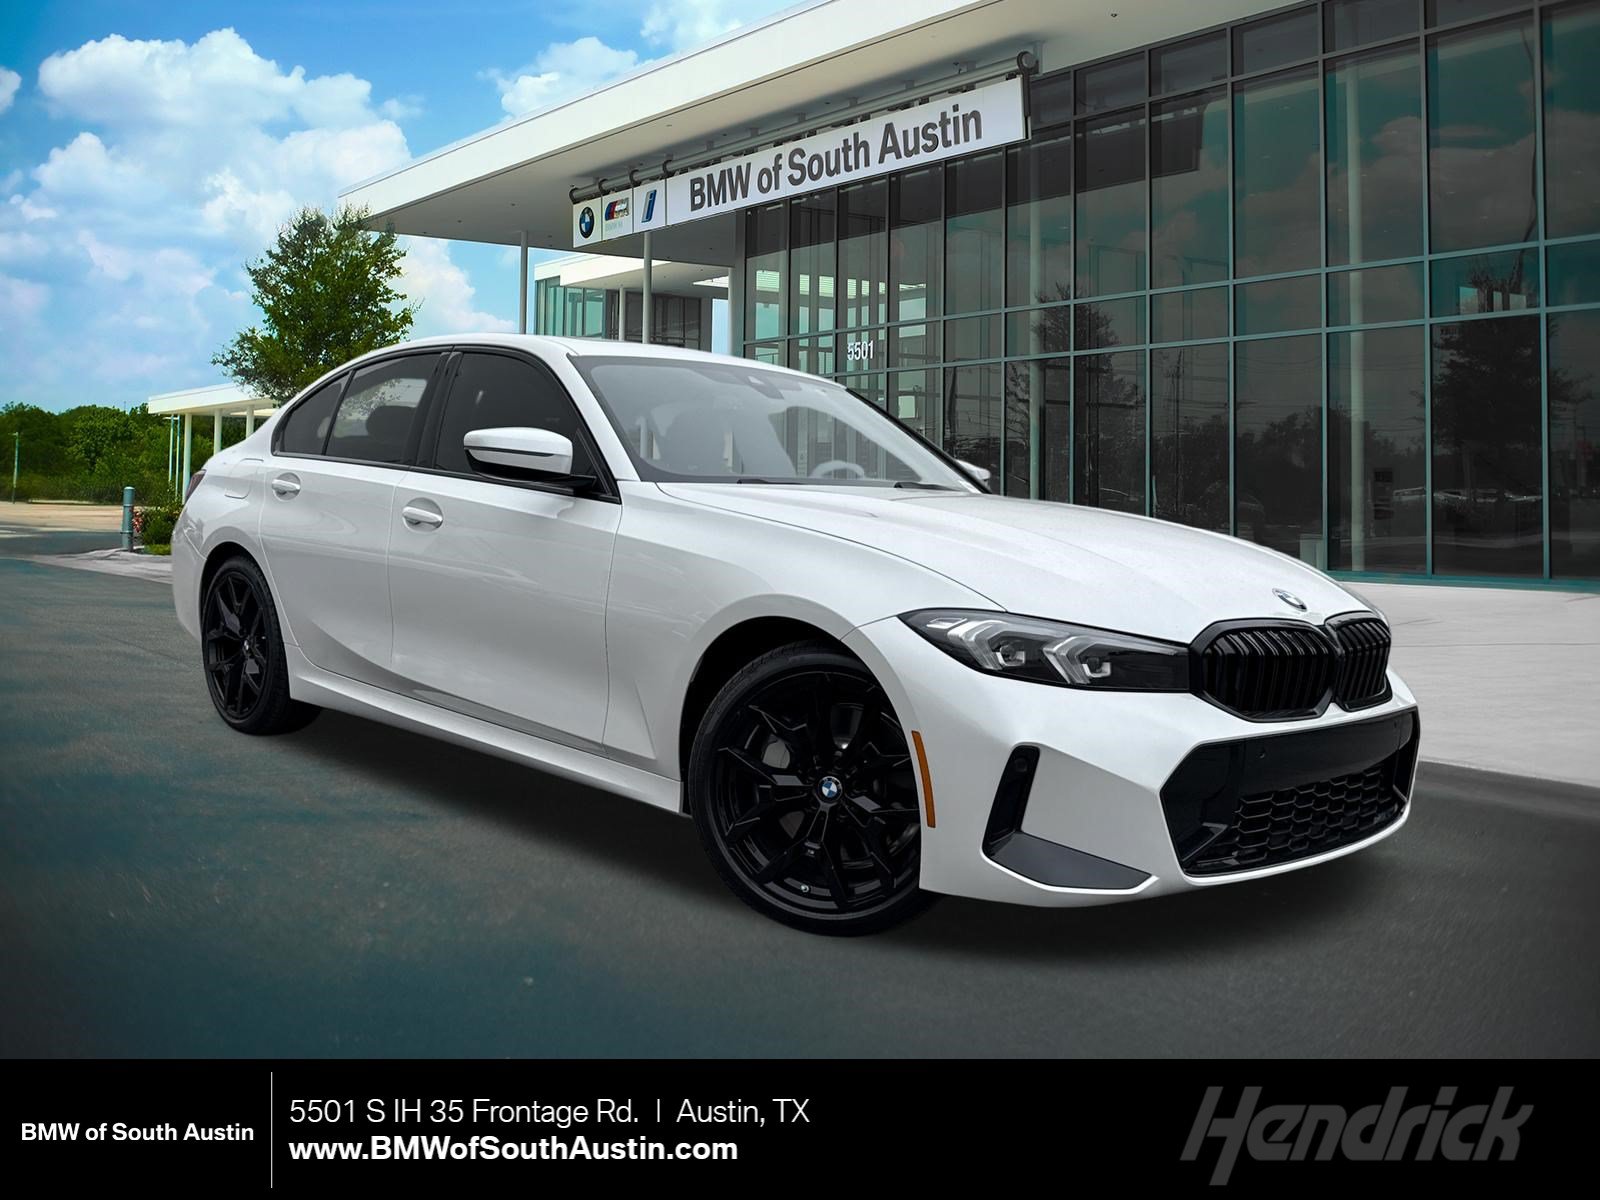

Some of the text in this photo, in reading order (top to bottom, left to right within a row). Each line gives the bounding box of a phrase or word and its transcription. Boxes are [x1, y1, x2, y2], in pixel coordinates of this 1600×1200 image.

[690, 103, 982, 212] BMW of South Austin
[847, 340, 874, 360] 5501
